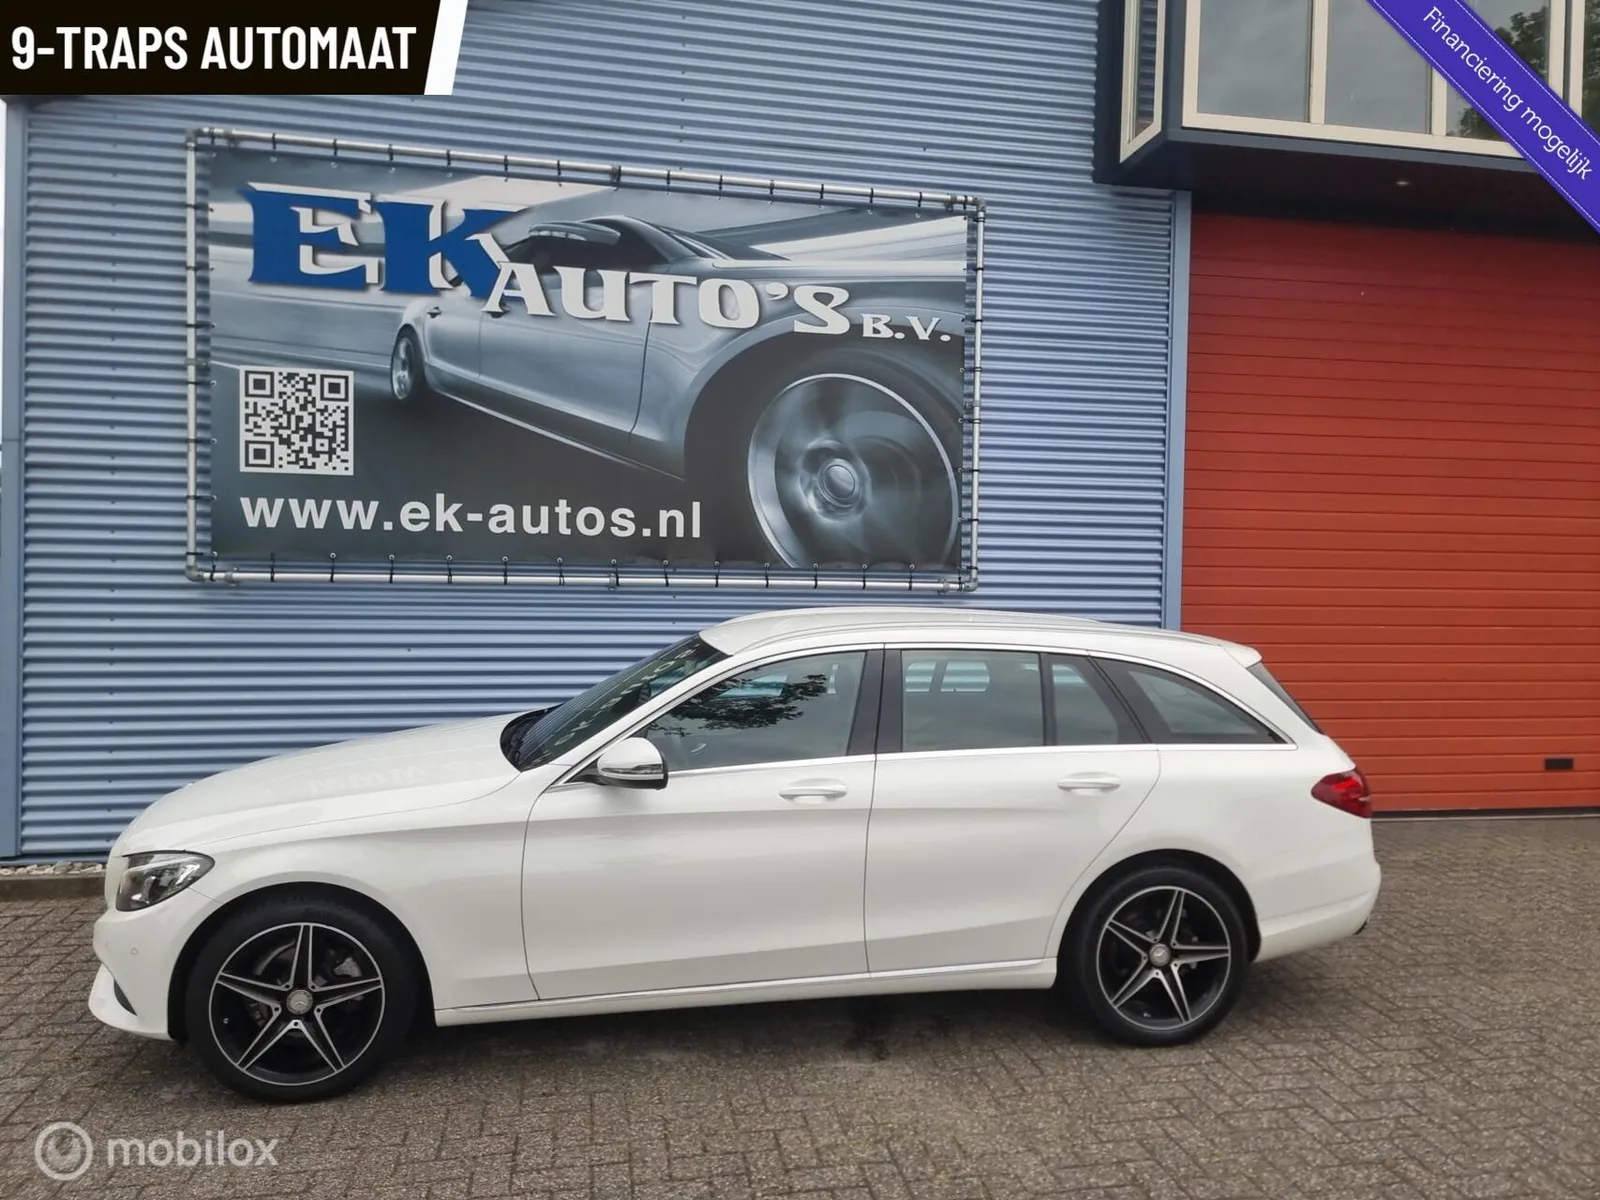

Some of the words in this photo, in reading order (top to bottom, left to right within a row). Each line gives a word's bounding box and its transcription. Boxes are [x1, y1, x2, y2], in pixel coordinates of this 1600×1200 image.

[241, 182, 532, 299] EK
[482, 260, 850, 335] AUTO'S
[861, 313, 951, 341] B.V.
[240, 493, 702, 538] www.ek-autos.nl
